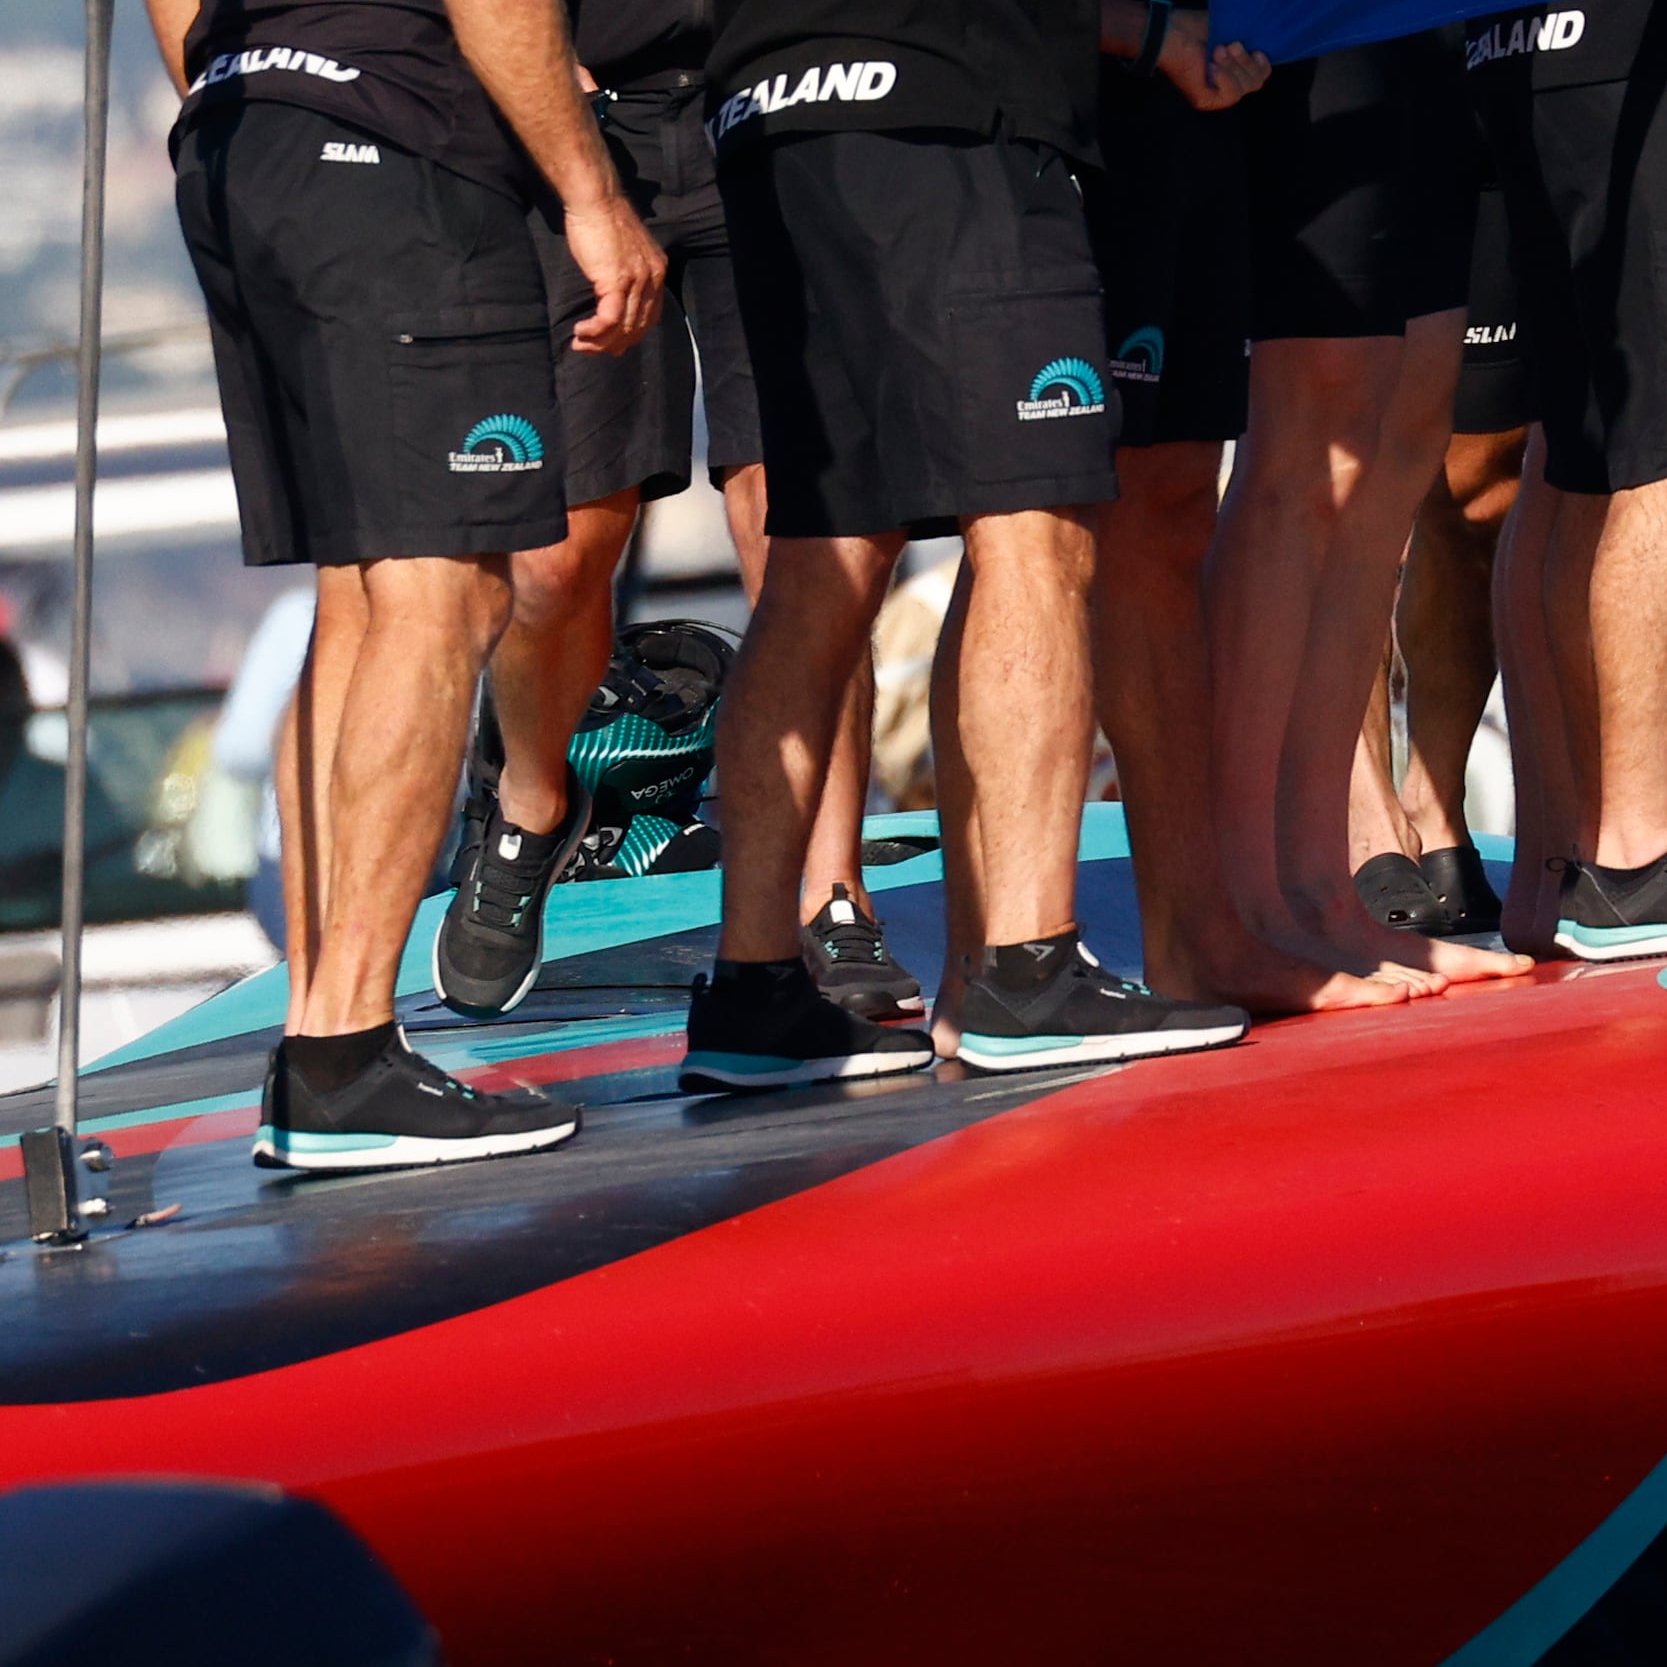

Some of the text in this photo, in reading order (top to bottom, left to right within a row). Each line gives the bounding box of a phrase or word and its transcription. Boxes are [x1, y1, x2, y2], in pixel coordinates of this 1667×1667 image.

[718, 61, 897, 141] ZEALAND
[320, 142, 380, 164] SLAM
[1016, 398, 1062, 412] Emirates
[1018, 403, 1105, 421] TEAM NEW ZEALAND
[630, 766, 694, 801] OMEGA
